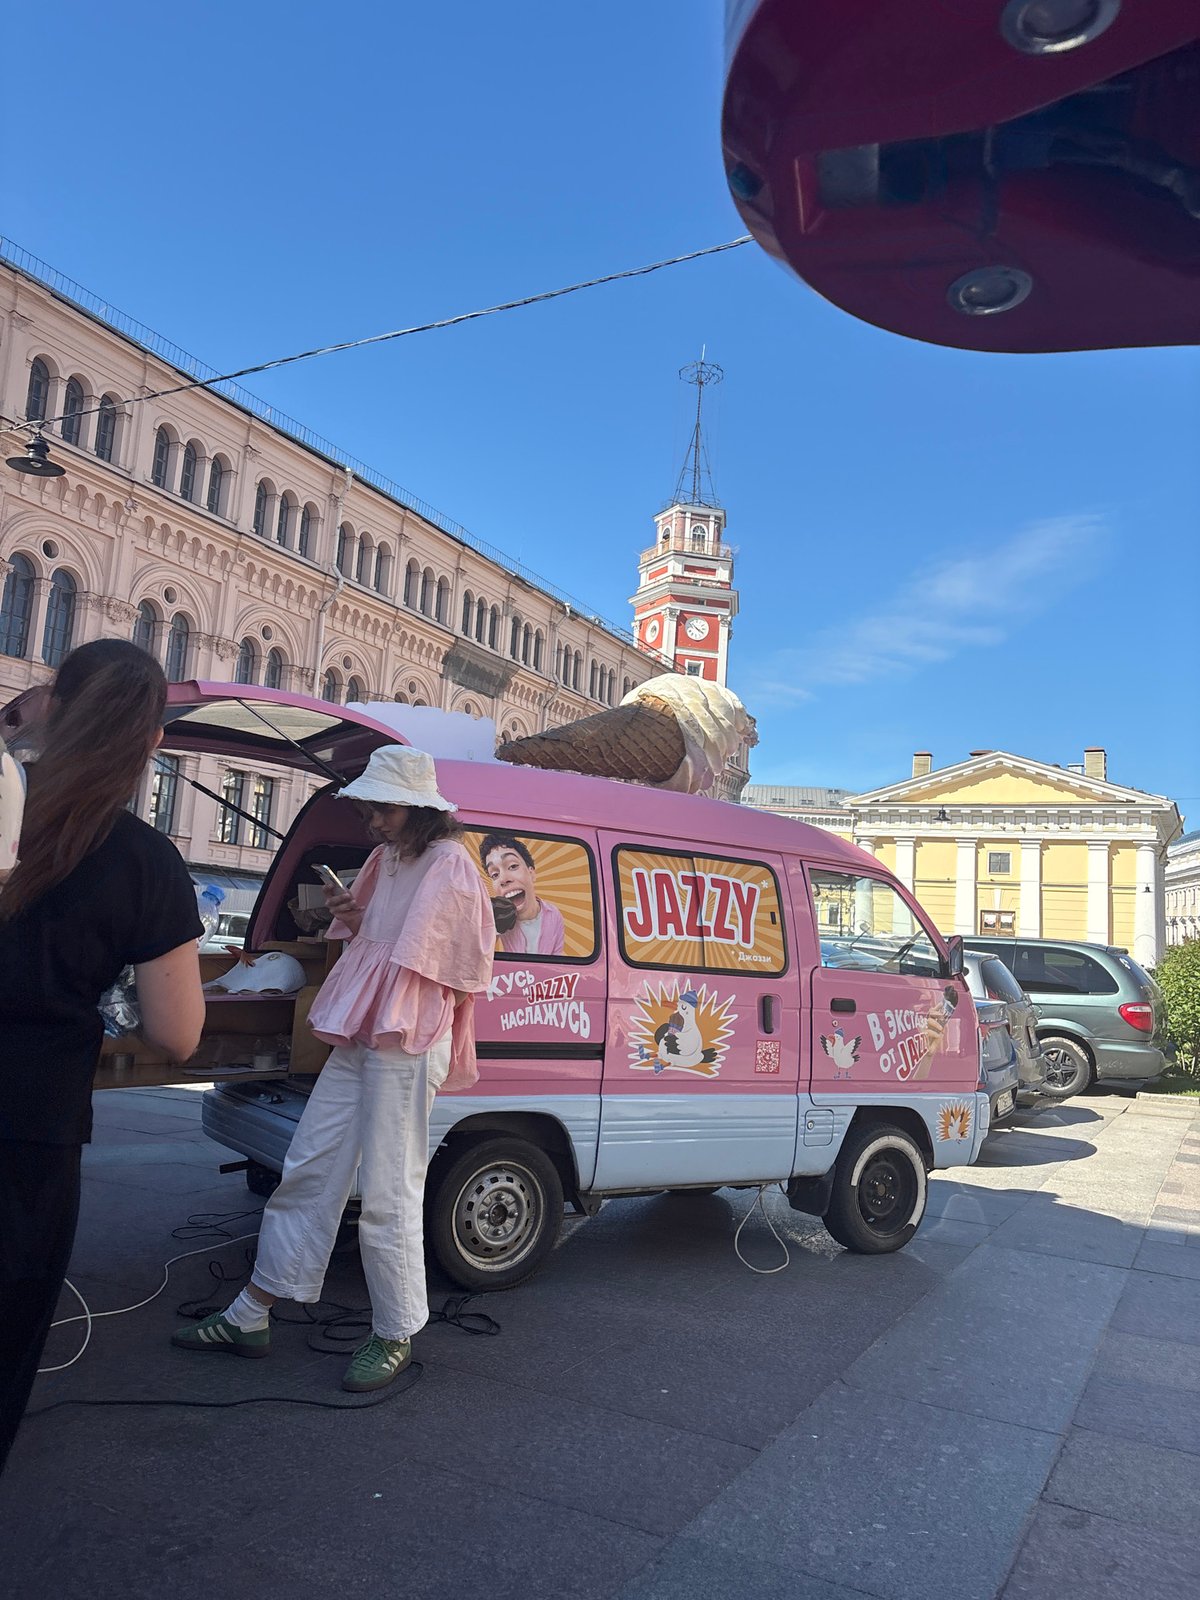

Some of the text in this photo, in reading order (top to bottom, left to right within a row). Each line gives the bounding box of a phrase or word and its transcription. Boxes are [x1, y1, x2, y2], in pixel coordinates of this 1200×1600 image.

[624, 868, 760, 948] JAZZY
[527, 972, 580, 1005] JAZZY
[500, 1001, 591, 1039] НАСЛАЖУСЬ
[866, 1012, 885, 1052] В
[896, 1032, 930, 1081] JAZZ
